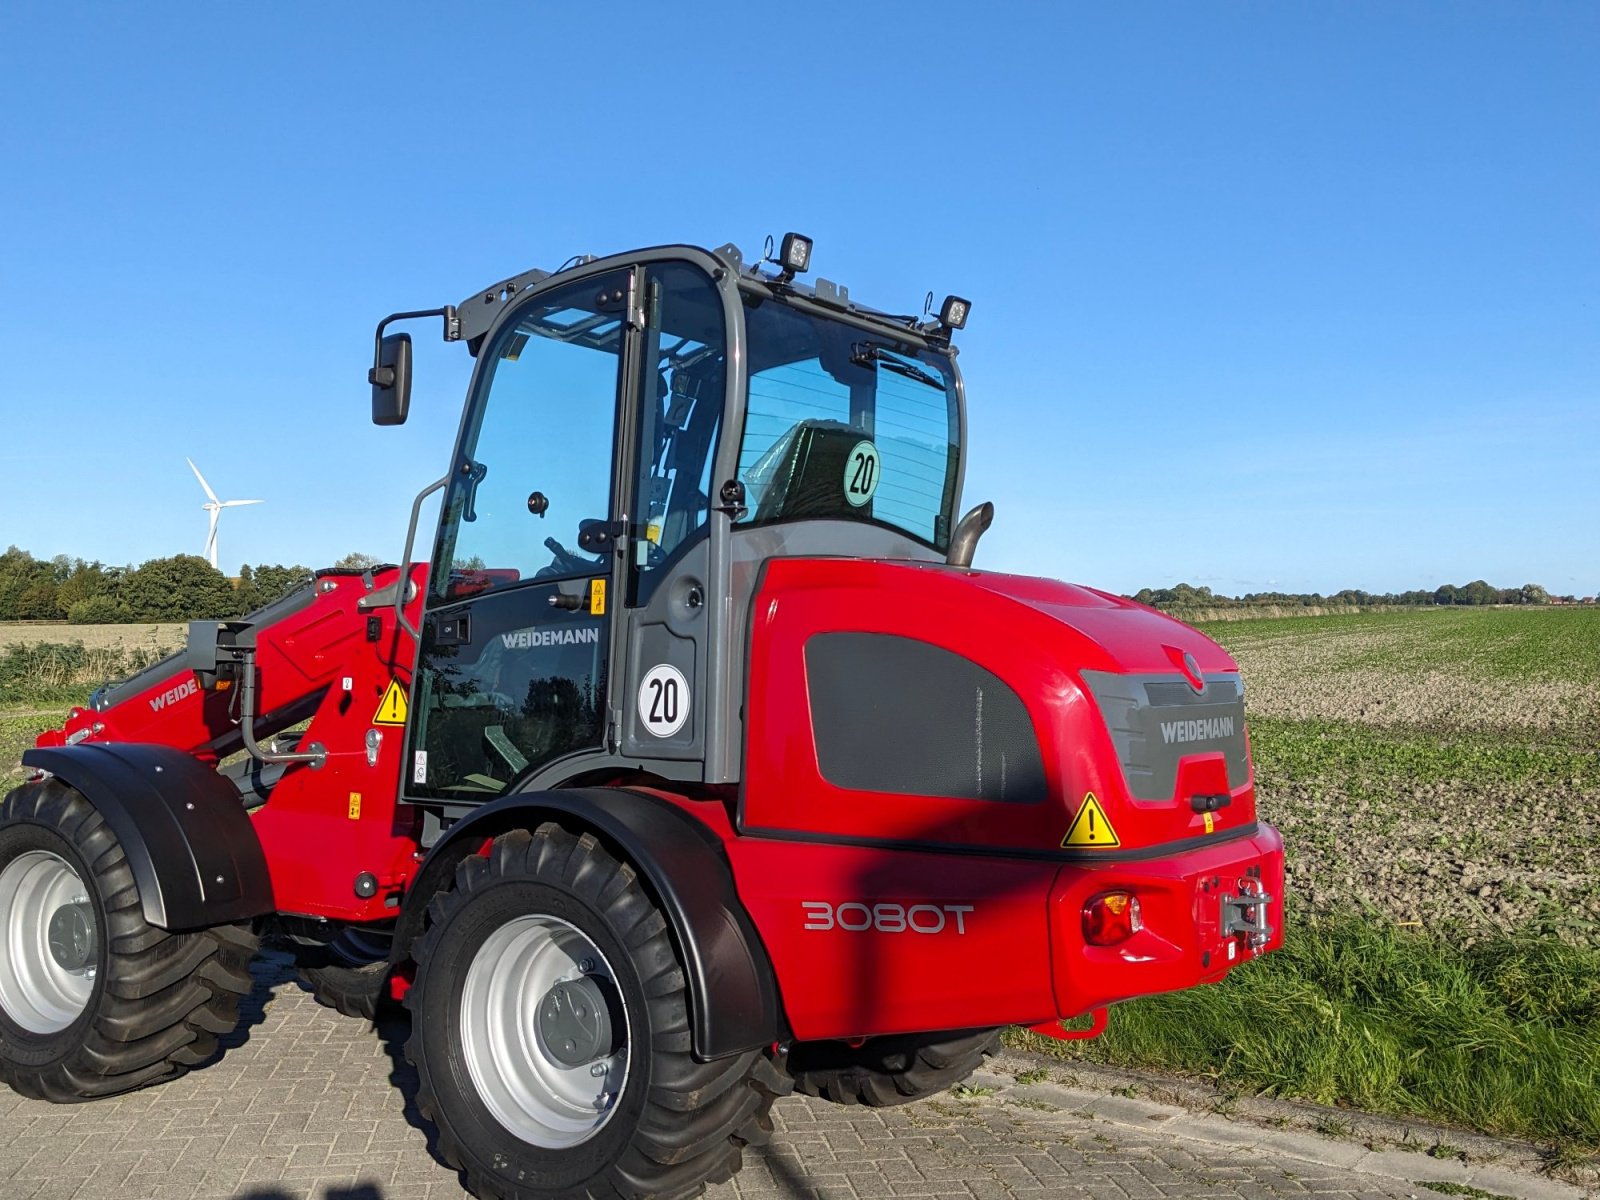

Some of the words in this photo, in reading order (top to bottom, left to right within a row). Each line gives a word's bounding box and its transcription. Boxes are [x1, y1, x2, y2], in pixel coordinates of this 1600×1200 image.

[849, 452, 875, 495] 20
[501, 627, 599, 648] WEIDEMANN
[149, 679, 198, 712] WEIDE
[649, 678, 678, 723] 20
[1160, 716, 1234, 745] WEIDEMANN
[802, 901, 974, 935] 3080T
